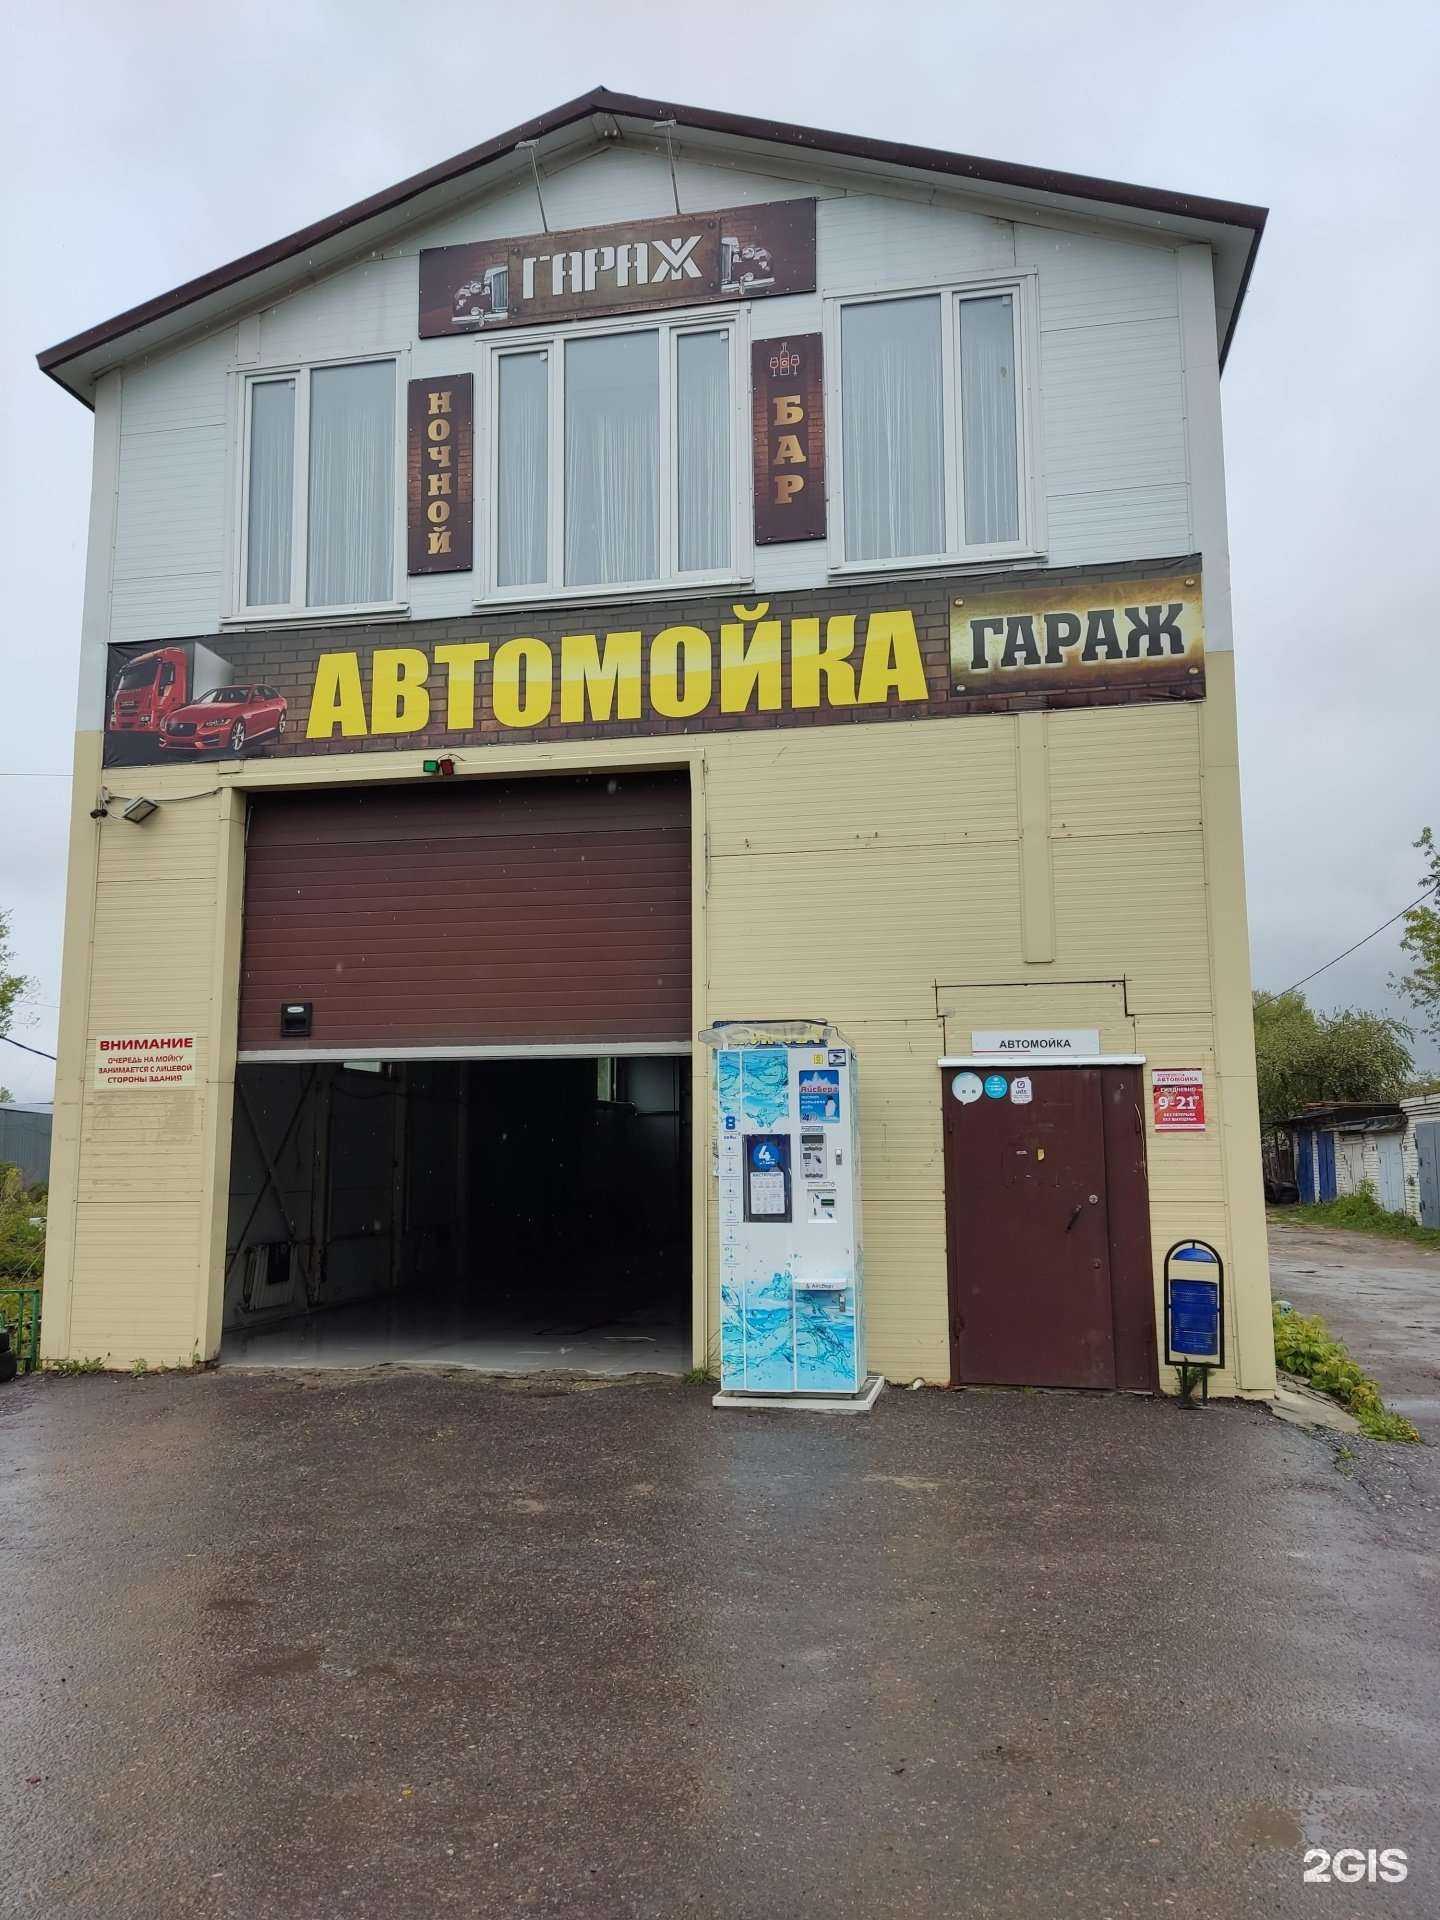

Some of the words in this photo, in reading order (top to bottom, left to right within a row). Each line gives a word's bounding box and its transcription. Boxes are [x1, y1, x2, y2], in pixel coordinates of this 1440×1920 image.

[522, 235, 704, 300] ГАРАЖ
[773, 395, 807, 505] БАР
[427, 391, 452, 555] НОЧНОЙ
[969, 603, 1186, 671] ГАРАЖ
[306, 602, 929, 740] АВТОМОЙКА
[100, 1037, 193, 1051] ВНИМАНИЕ
[155, 1054, 184, 1063] МОЙКУ
[999, 1038, 1072, 1049] АВТОМОЙКА
[98, 1066, 149, 1074] ЗАНИМАЕТСЯ
[156, 1064, 193, 1073] ЛИЦЕВОЙ
[107, 1076, 147, 1084] СТОРОНЫ
[149, 1075, 183, 1083] ЗДАНИЯ
